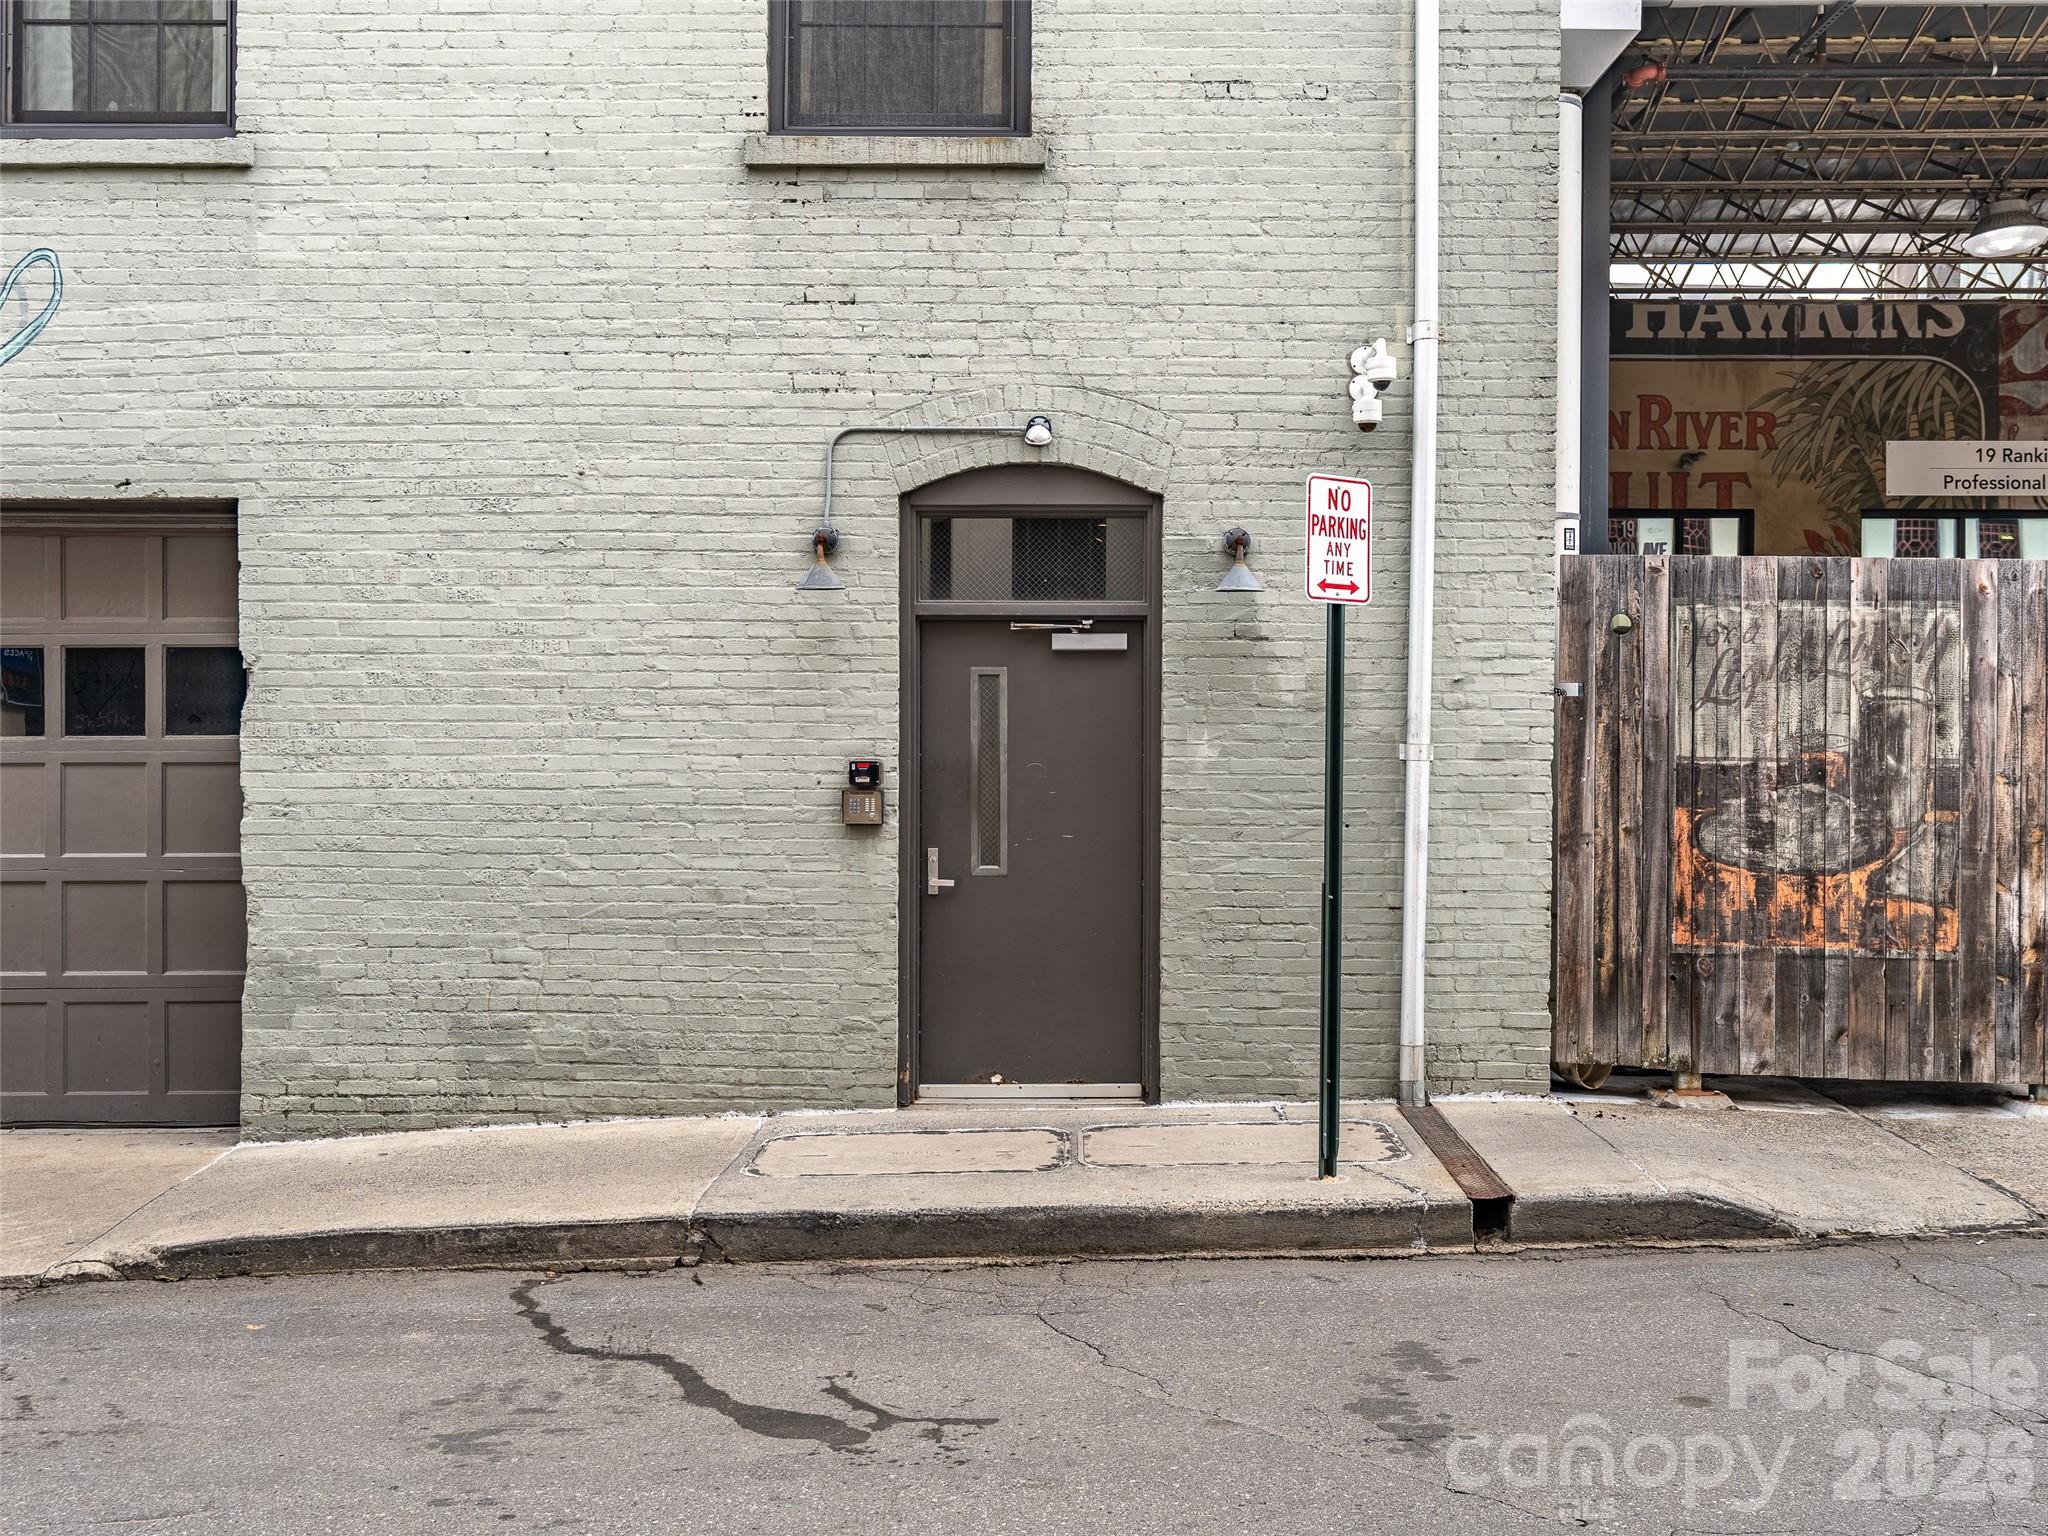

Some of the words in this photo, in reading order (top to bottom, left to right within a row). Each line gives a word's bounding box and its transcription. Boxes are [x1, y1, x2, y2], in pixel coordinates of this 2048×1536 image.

[1625, 302, 1966, 339] HAWKINS
[1637, 394, 1779, 450] RIVER
[1975, 447, 1997, 463] 19
[2003, 446, 2048, 463] Ranki
[1944, 473, 2046, 490] Professional
[1327, 487, 1352, 512] NO
[1311, 513, 1367, 541] PARKING
[1326, 541, 1351, 558] ANY
[1323, 559, 1354, 577] TIME
